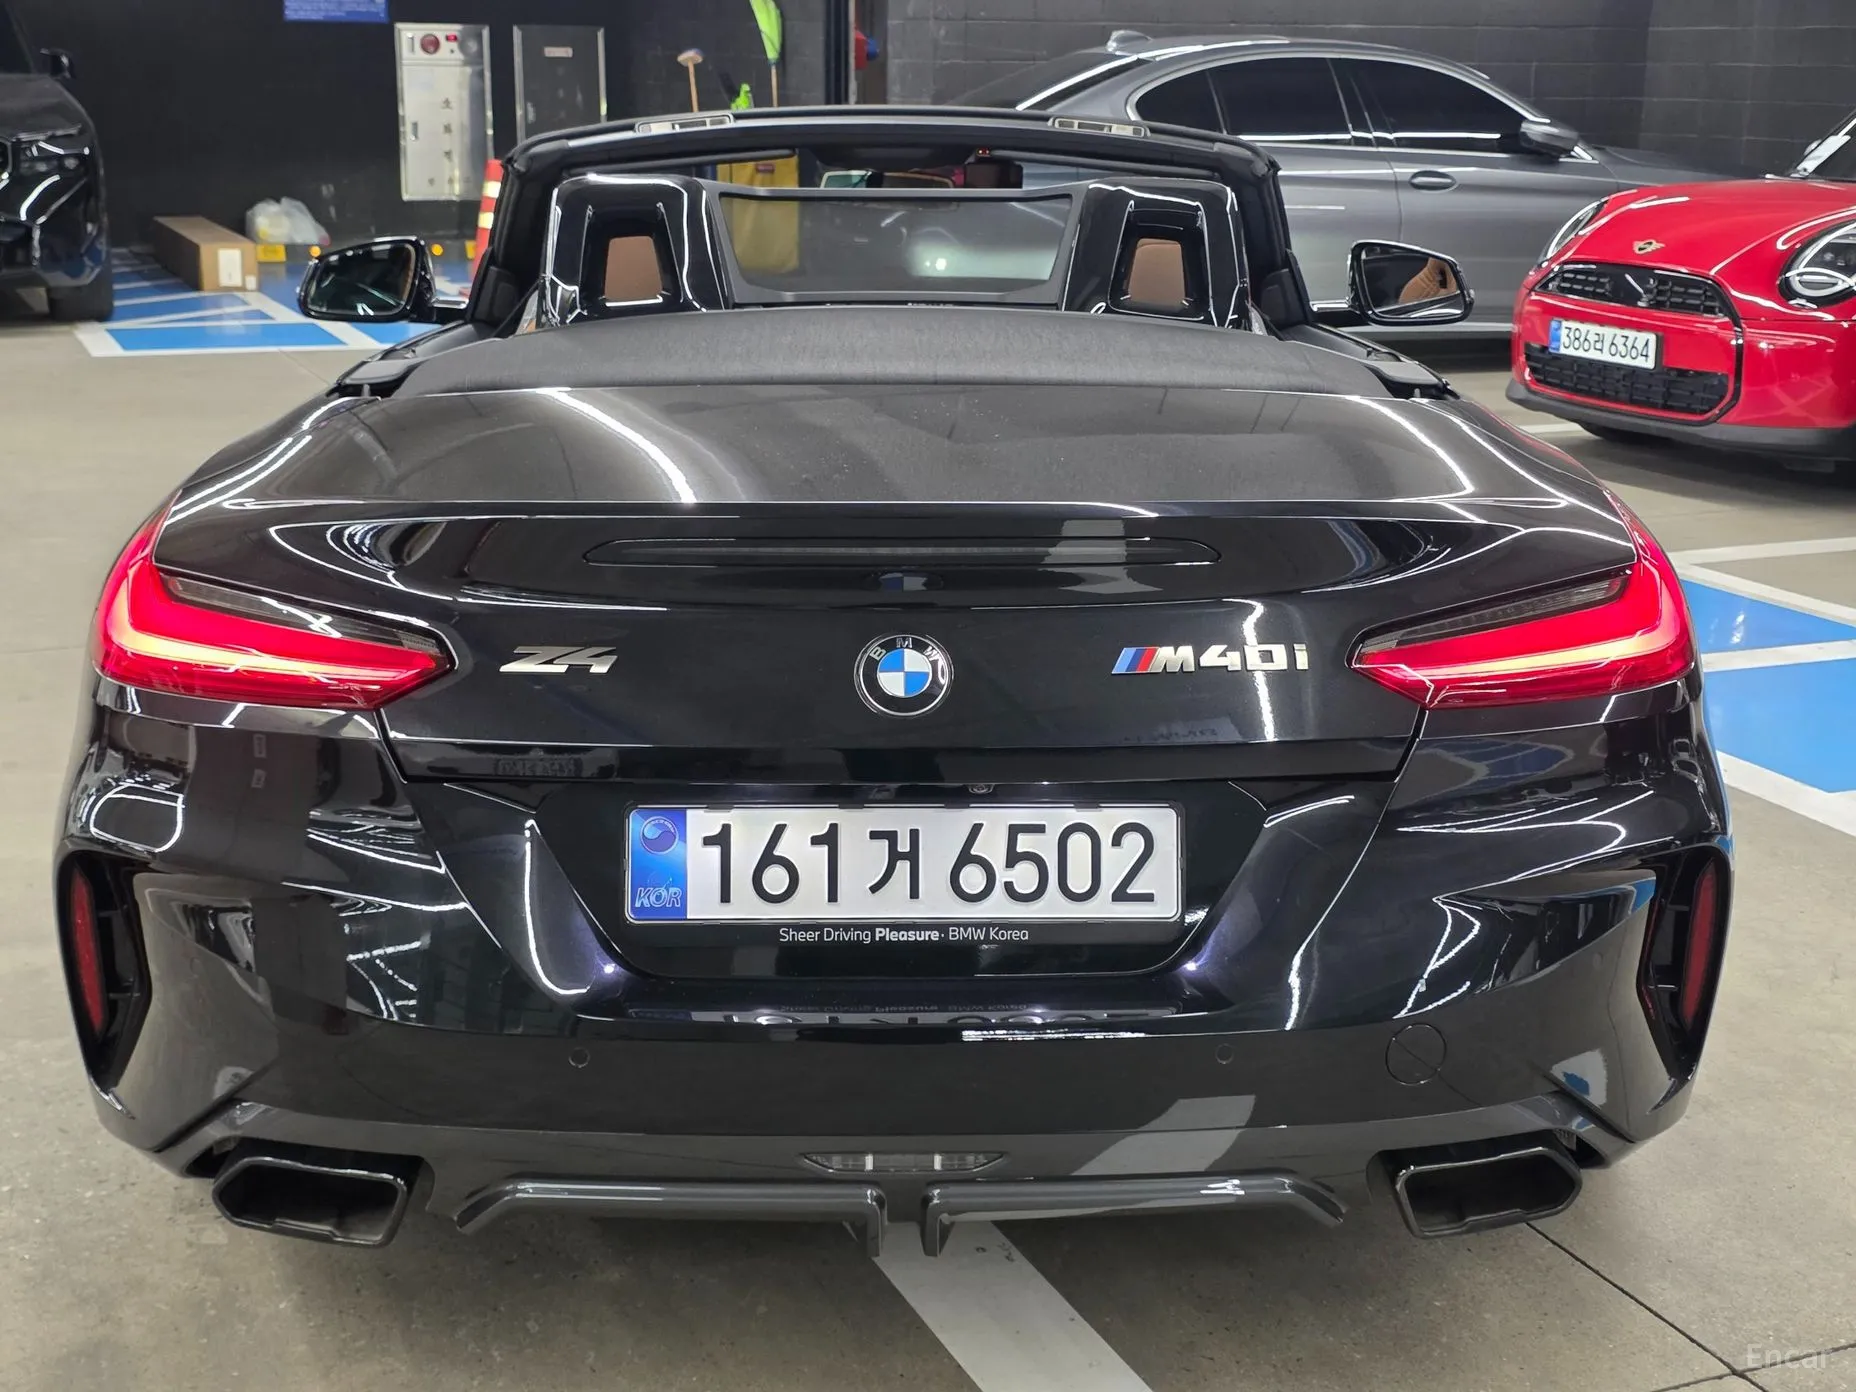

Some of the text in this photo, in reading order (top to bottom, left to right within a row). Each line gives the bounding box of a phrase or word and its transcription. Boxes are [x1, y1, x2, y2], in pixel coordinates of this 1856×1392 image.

[499, 646, 618, 673] Z4
[1148, 643, 1309, 673] M40i
[635, 887, 682, 907] KOR
[779, 928, 820, 942] Sheer
[824, 928, 871, 944] Driving
[949, 927, 986, 940] BMW
[989, 927, 1029, 941] Korea
